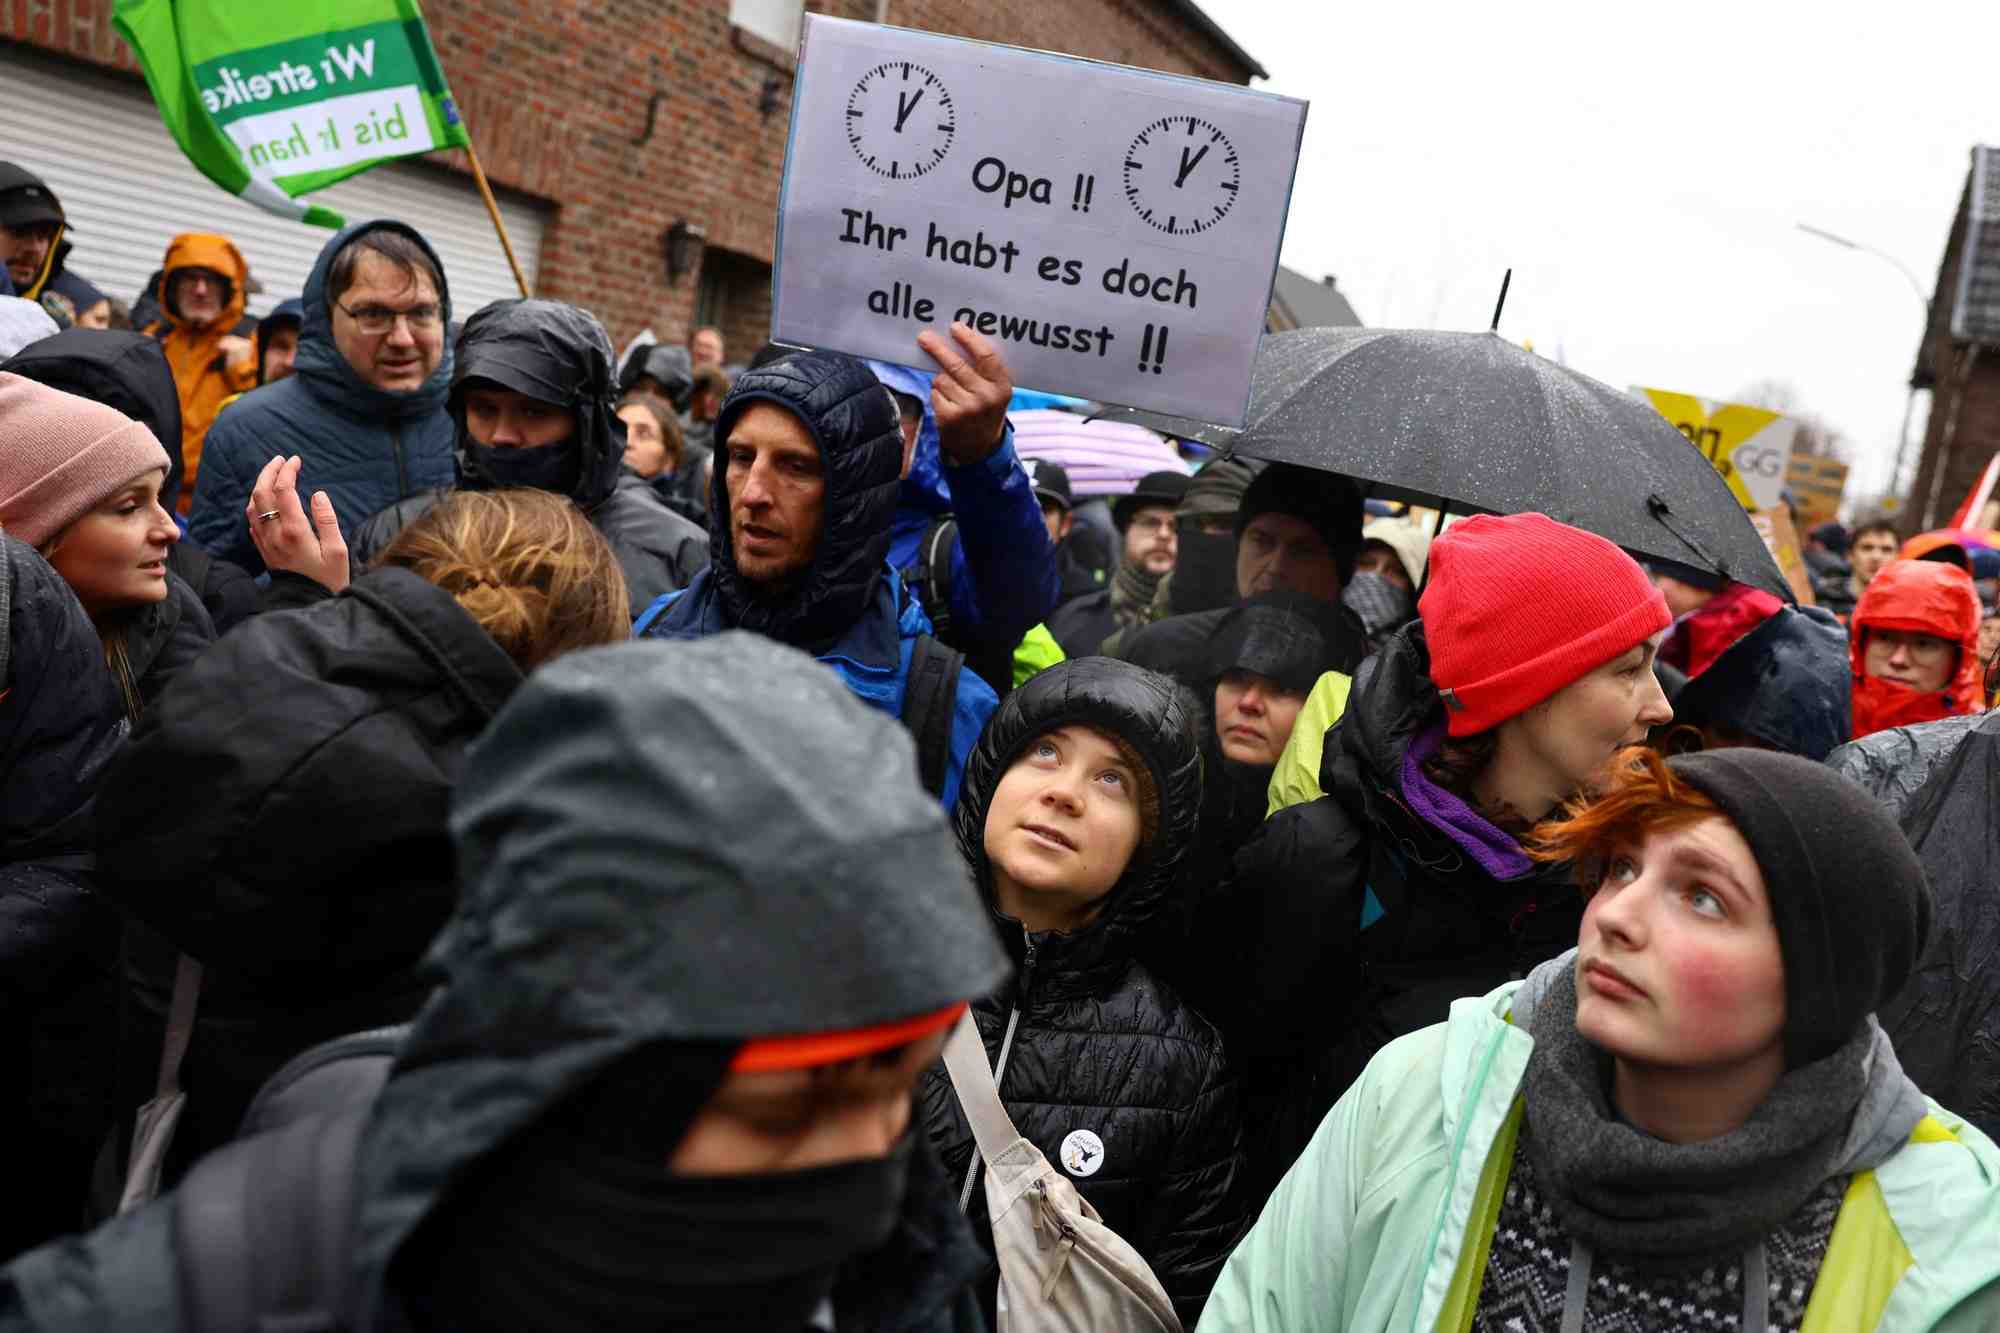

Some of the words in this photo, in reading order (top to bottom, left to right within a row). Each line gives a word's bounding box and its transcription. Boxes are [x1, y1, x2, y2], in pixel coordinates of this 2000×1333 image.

[971, 156, 1052, 209] Opa
[1071, 173, 1095, 213] !!
[839, 208, 907, 252] Ihr
[926, 222, 1020, 273] habt
[1037, 256, 1083, 286] es
[1102, 258, 1198, 308] doch
[867, 281, 935, 323] alle
[1137, 323, 1169, 375] !!
